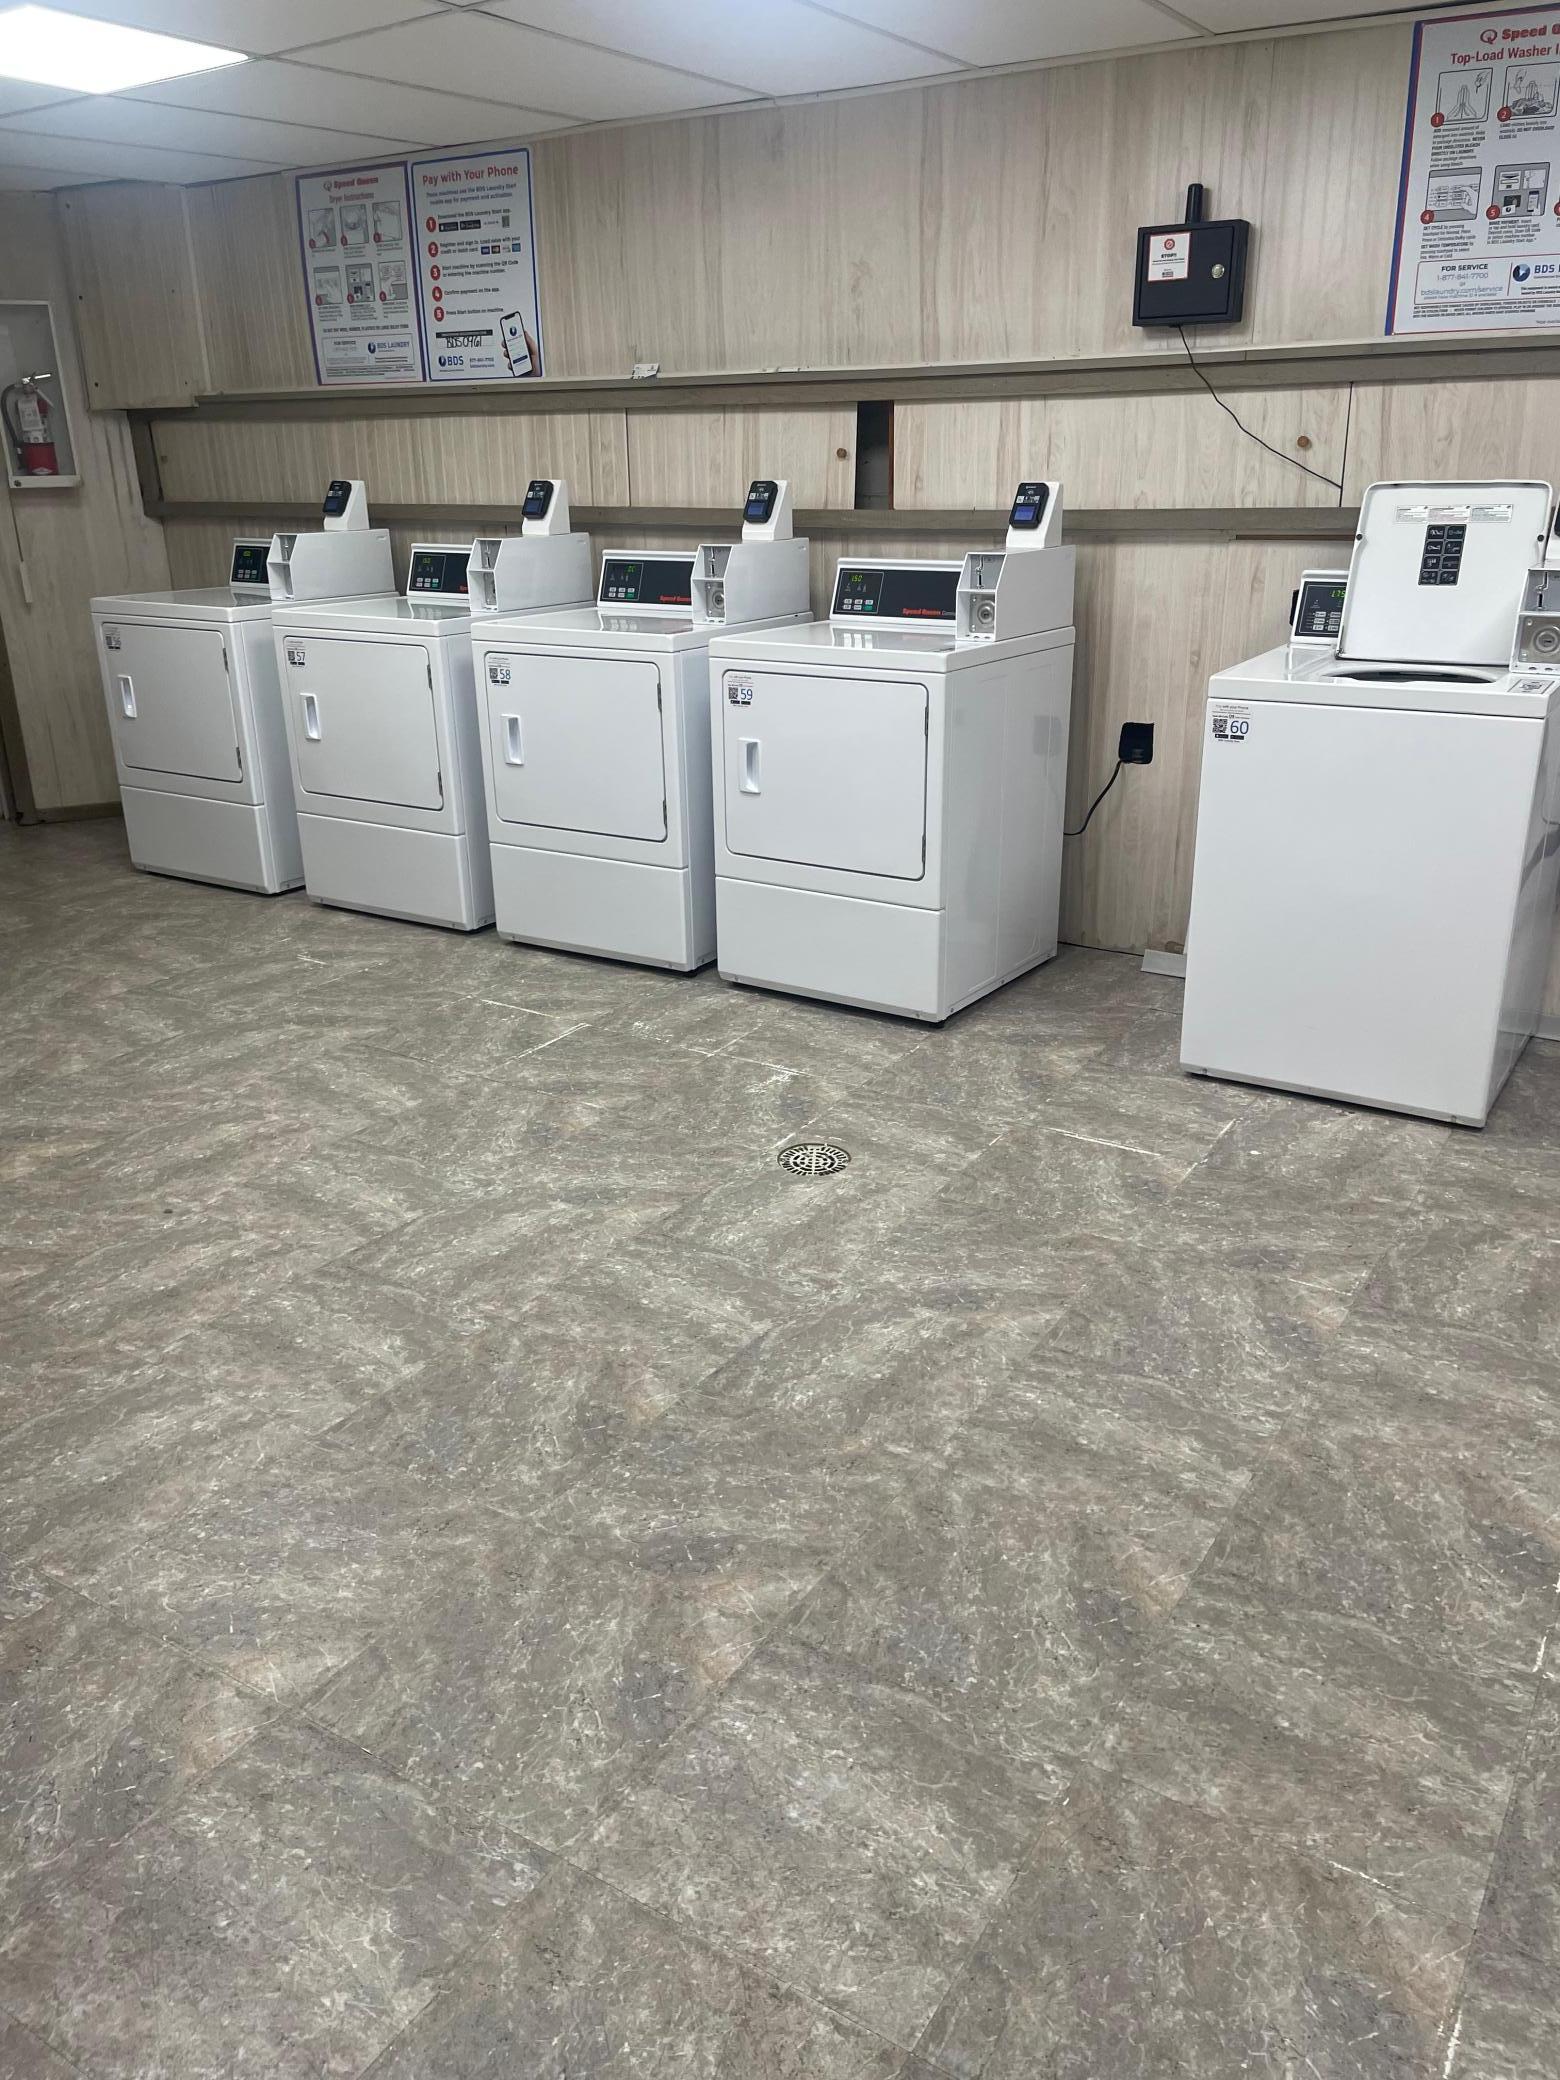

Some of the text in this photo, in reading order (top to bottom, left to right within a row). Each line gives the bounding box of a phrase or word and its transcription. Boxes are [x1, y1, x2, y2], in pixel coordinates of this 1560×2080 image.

[1502, 26, 1547, 42] Speed
[1451, 48, 1504, 66] Top-Load
[1508, 45, 1552, 59] Washer
[423, 166, 519, 187] Pay with Your Phone
[1458, 264, 1489, 272] SERVICE
[1535, 265, 1555, 274] BDS
[448, 356, 464, 366] BDS
[297, 652, 306, 662] 57
[500, 669, 511, 680] 58
[741, 689, 753, 701] 59
[1230, 720, 1249, 735] 60
